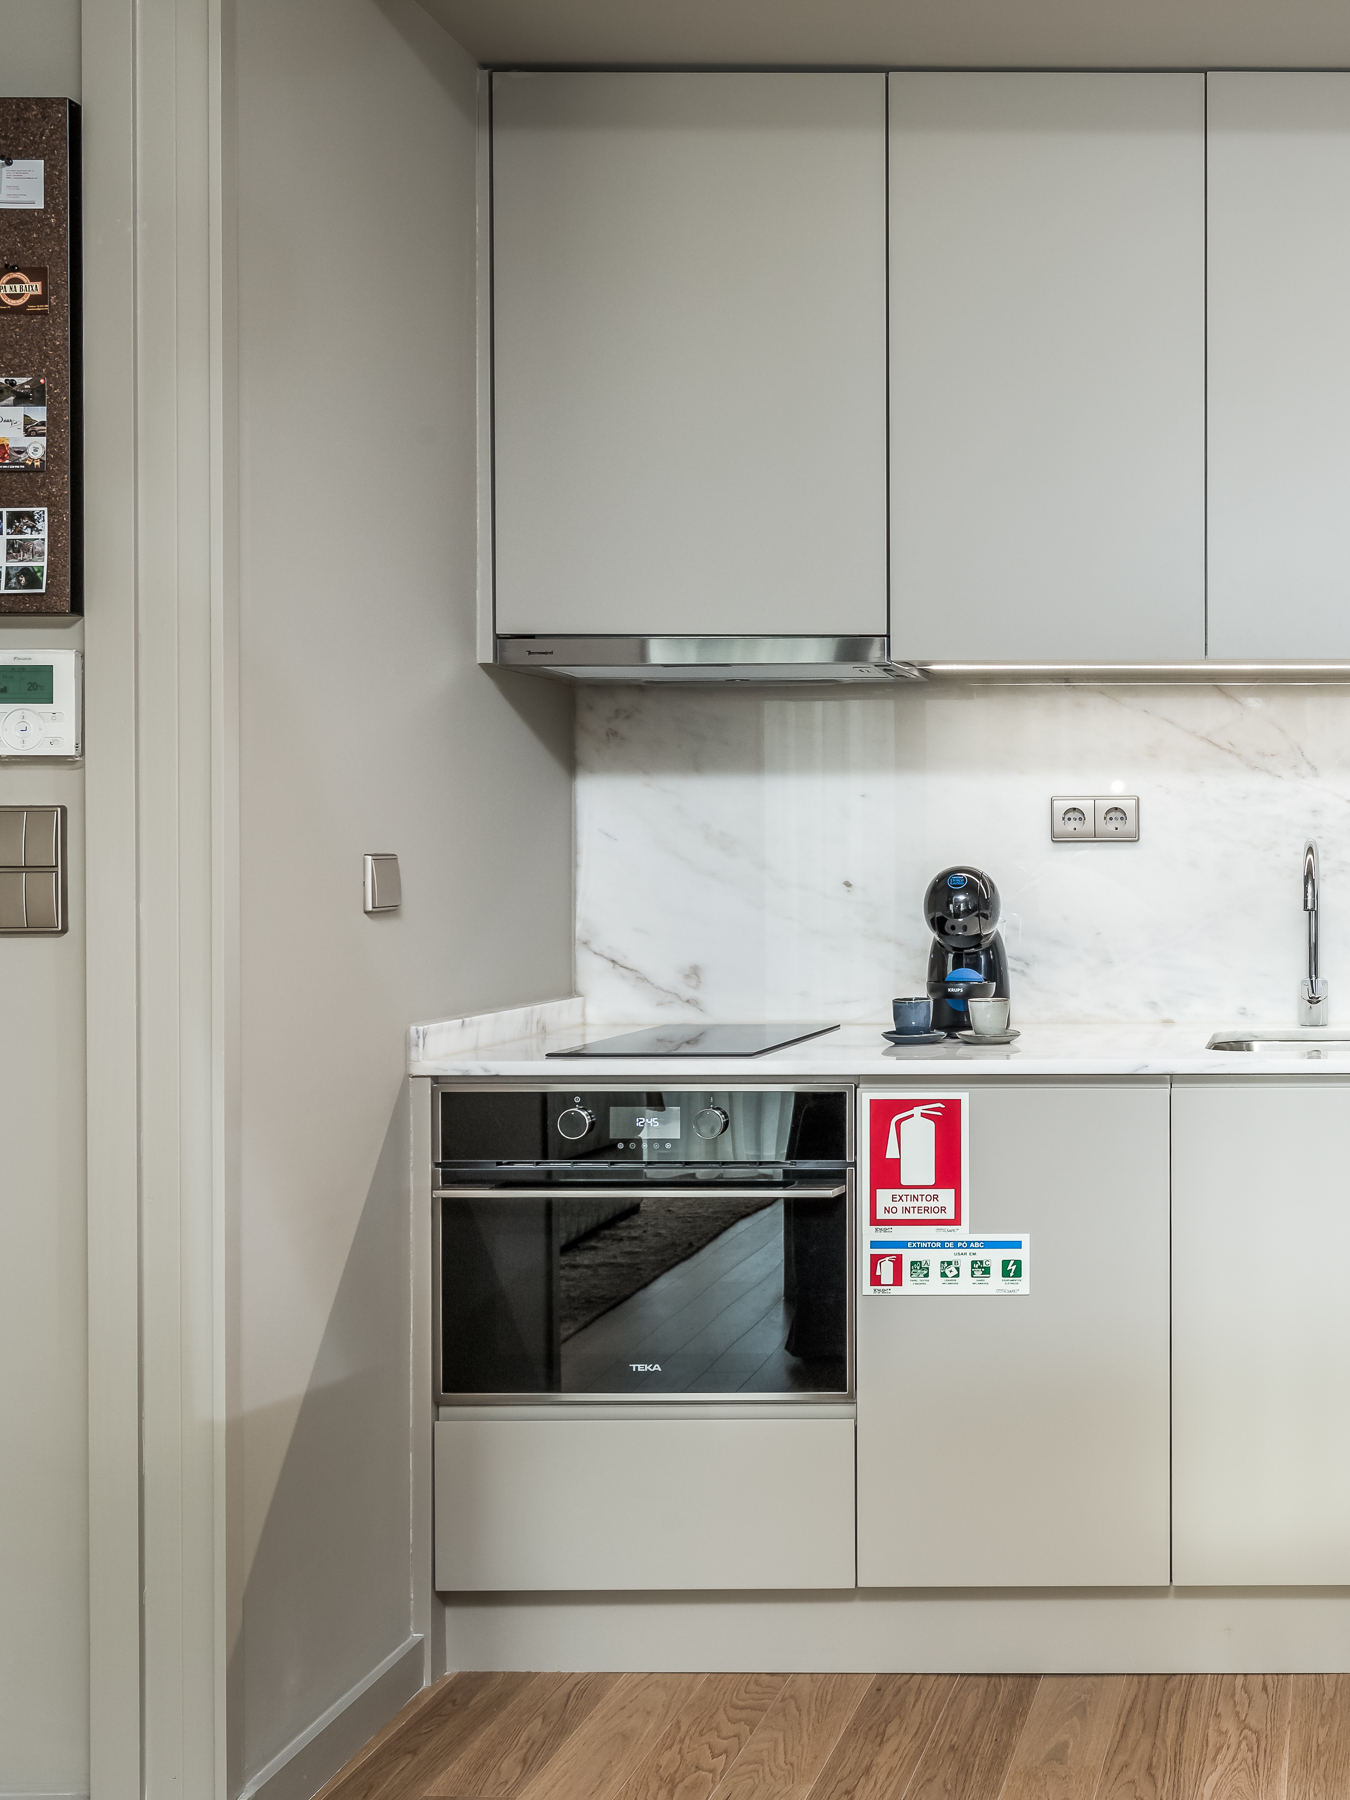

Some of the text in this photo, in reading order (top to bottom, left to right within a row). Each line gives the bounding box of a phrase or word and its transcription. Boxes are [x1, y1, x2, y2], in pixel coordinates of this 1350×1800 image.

[20, 284, 39, 292] BAIXA
[891, 1194, 939, 1202] EXTINTOR
[883, 1206, 947, 1214] NO INTERIOR
